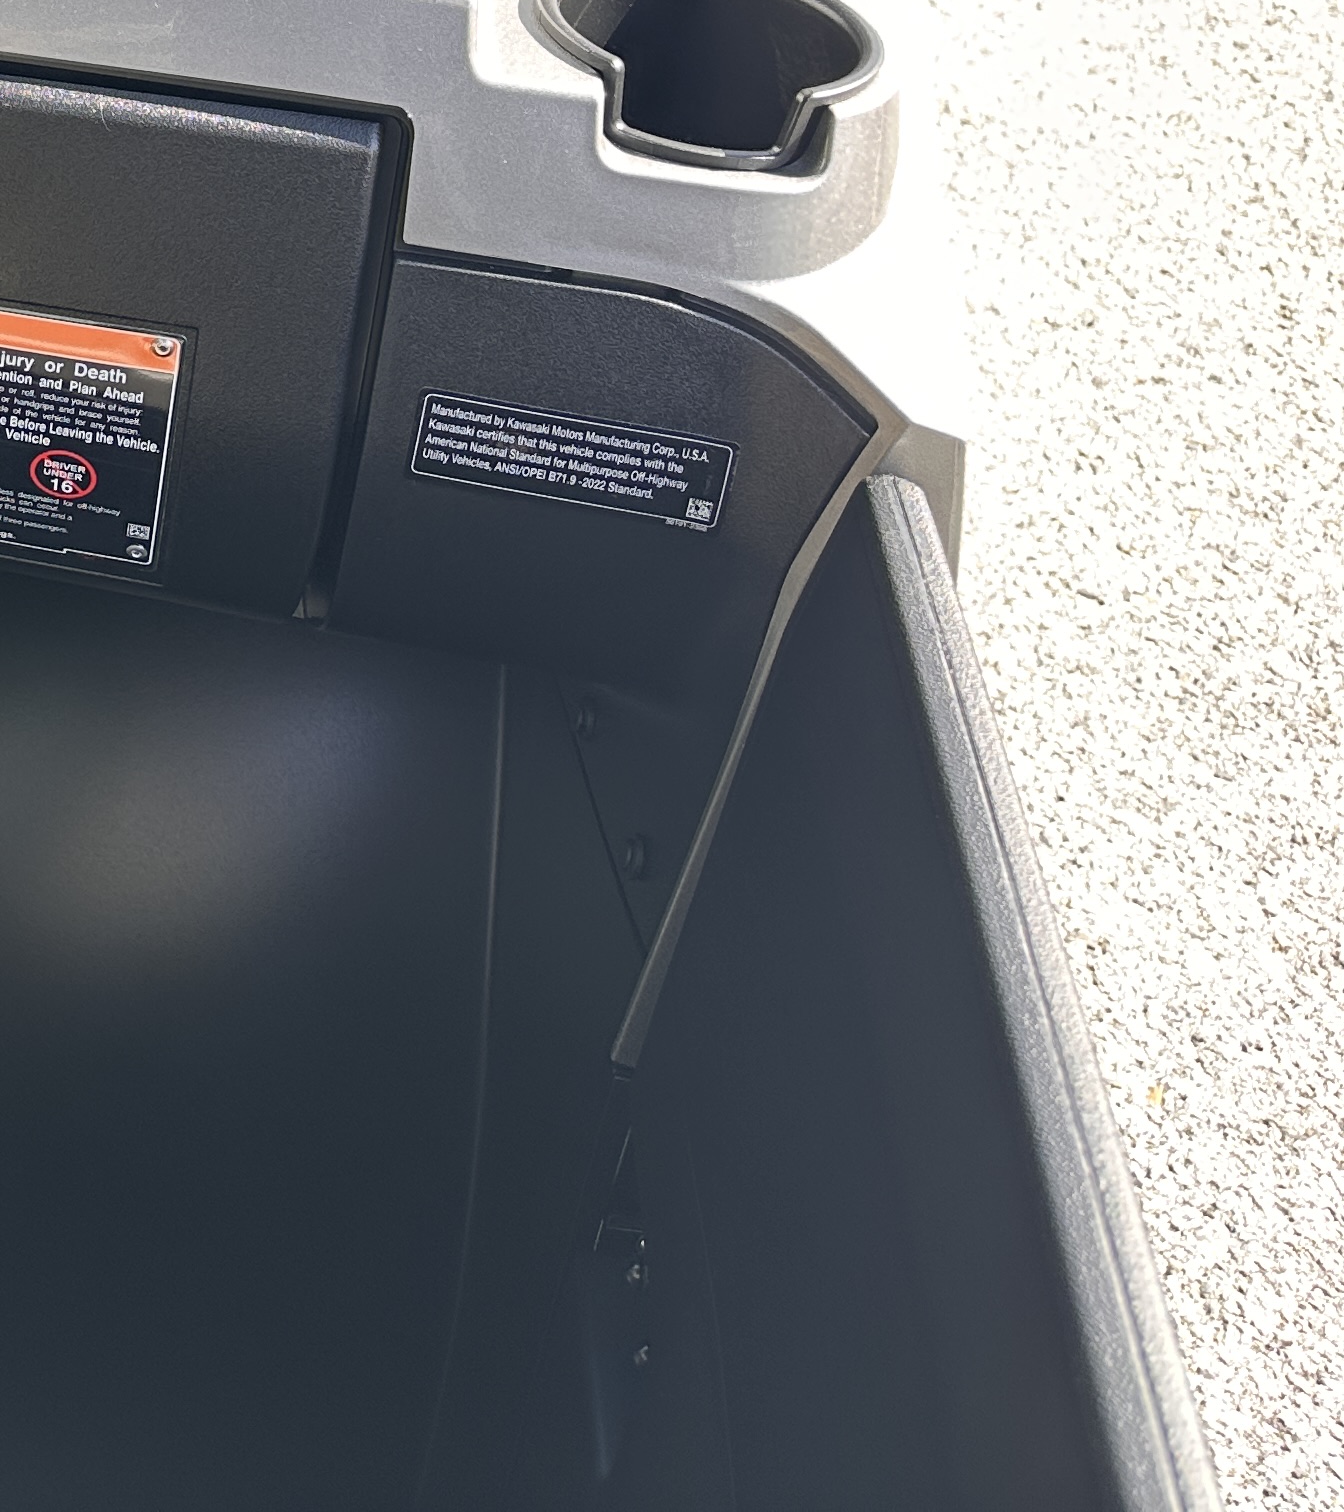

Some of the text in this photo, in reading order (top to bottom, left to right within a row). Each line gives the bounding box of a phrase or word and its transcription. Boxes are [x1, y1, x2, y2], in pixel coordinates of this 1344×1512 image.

[44, 360, 64, 373] or
[74, 362, 126, 384] Death
[38, 377, 63, 390] and
[69, 380, 96, 396] Plan
[102, 386, 144, 404] Ahead
[5, 427, 51, 446] Vehicle
[9, 415, 47, 433] Before
[48, 422, 93, 443] Leaving
[95, 429, 114, 445] the
[116, 434, 160, 453] Vehicle.
[430, 402, 493, 425] Manufactured
[493, 414, 506, 429] by
[506, 416, 550, 435] Kawasaki
[551, 424, 584, 441] Motors
[584, 430, 651, 455] Manufacturing
[428, 417, 684, 474] Kawasaki certifies that this vehicle complies with the
[42, 467, 83, 482] UNDER
[43, 459, 86, 474] DRIVER
[422, 447, 450, 464] Utility
[607, 481, 653, 499] Standard.
[424, 433, 468, 450] American
[469, 441, 509, 458] National
[508, 446, 552, 466] Standard
[552, 456, 567, 468] for
[630, 470, 688, 492] Off-Highway
[50, 477, 74, 493] 16
